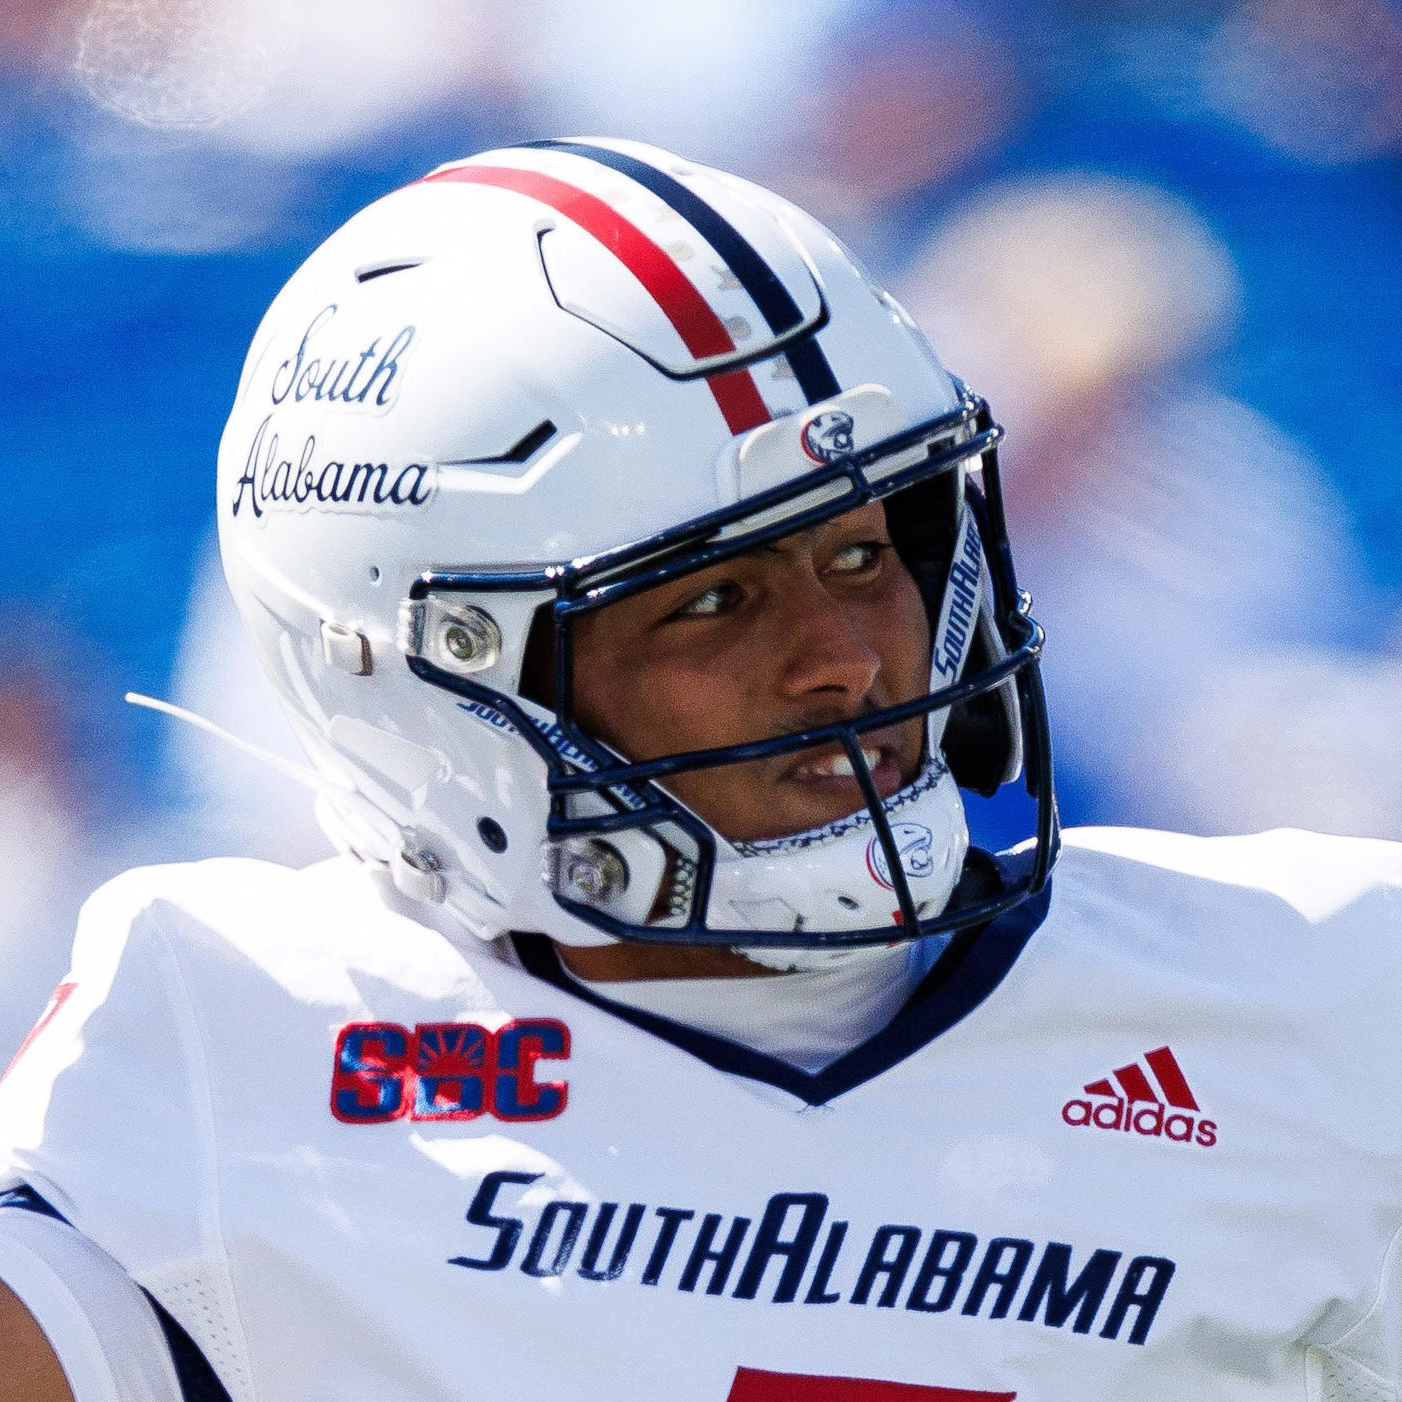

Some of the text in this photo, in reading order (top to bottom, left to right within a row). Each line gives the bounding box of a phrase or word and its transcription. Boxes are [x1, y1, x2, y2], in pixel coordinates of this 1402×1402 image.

[271, 304, 417, 406] South
[232, 412, 431, 518] Alabama
[330, 1017, 572, 1125] SBC
[1060, 1091, 1219, 1149] adidas
